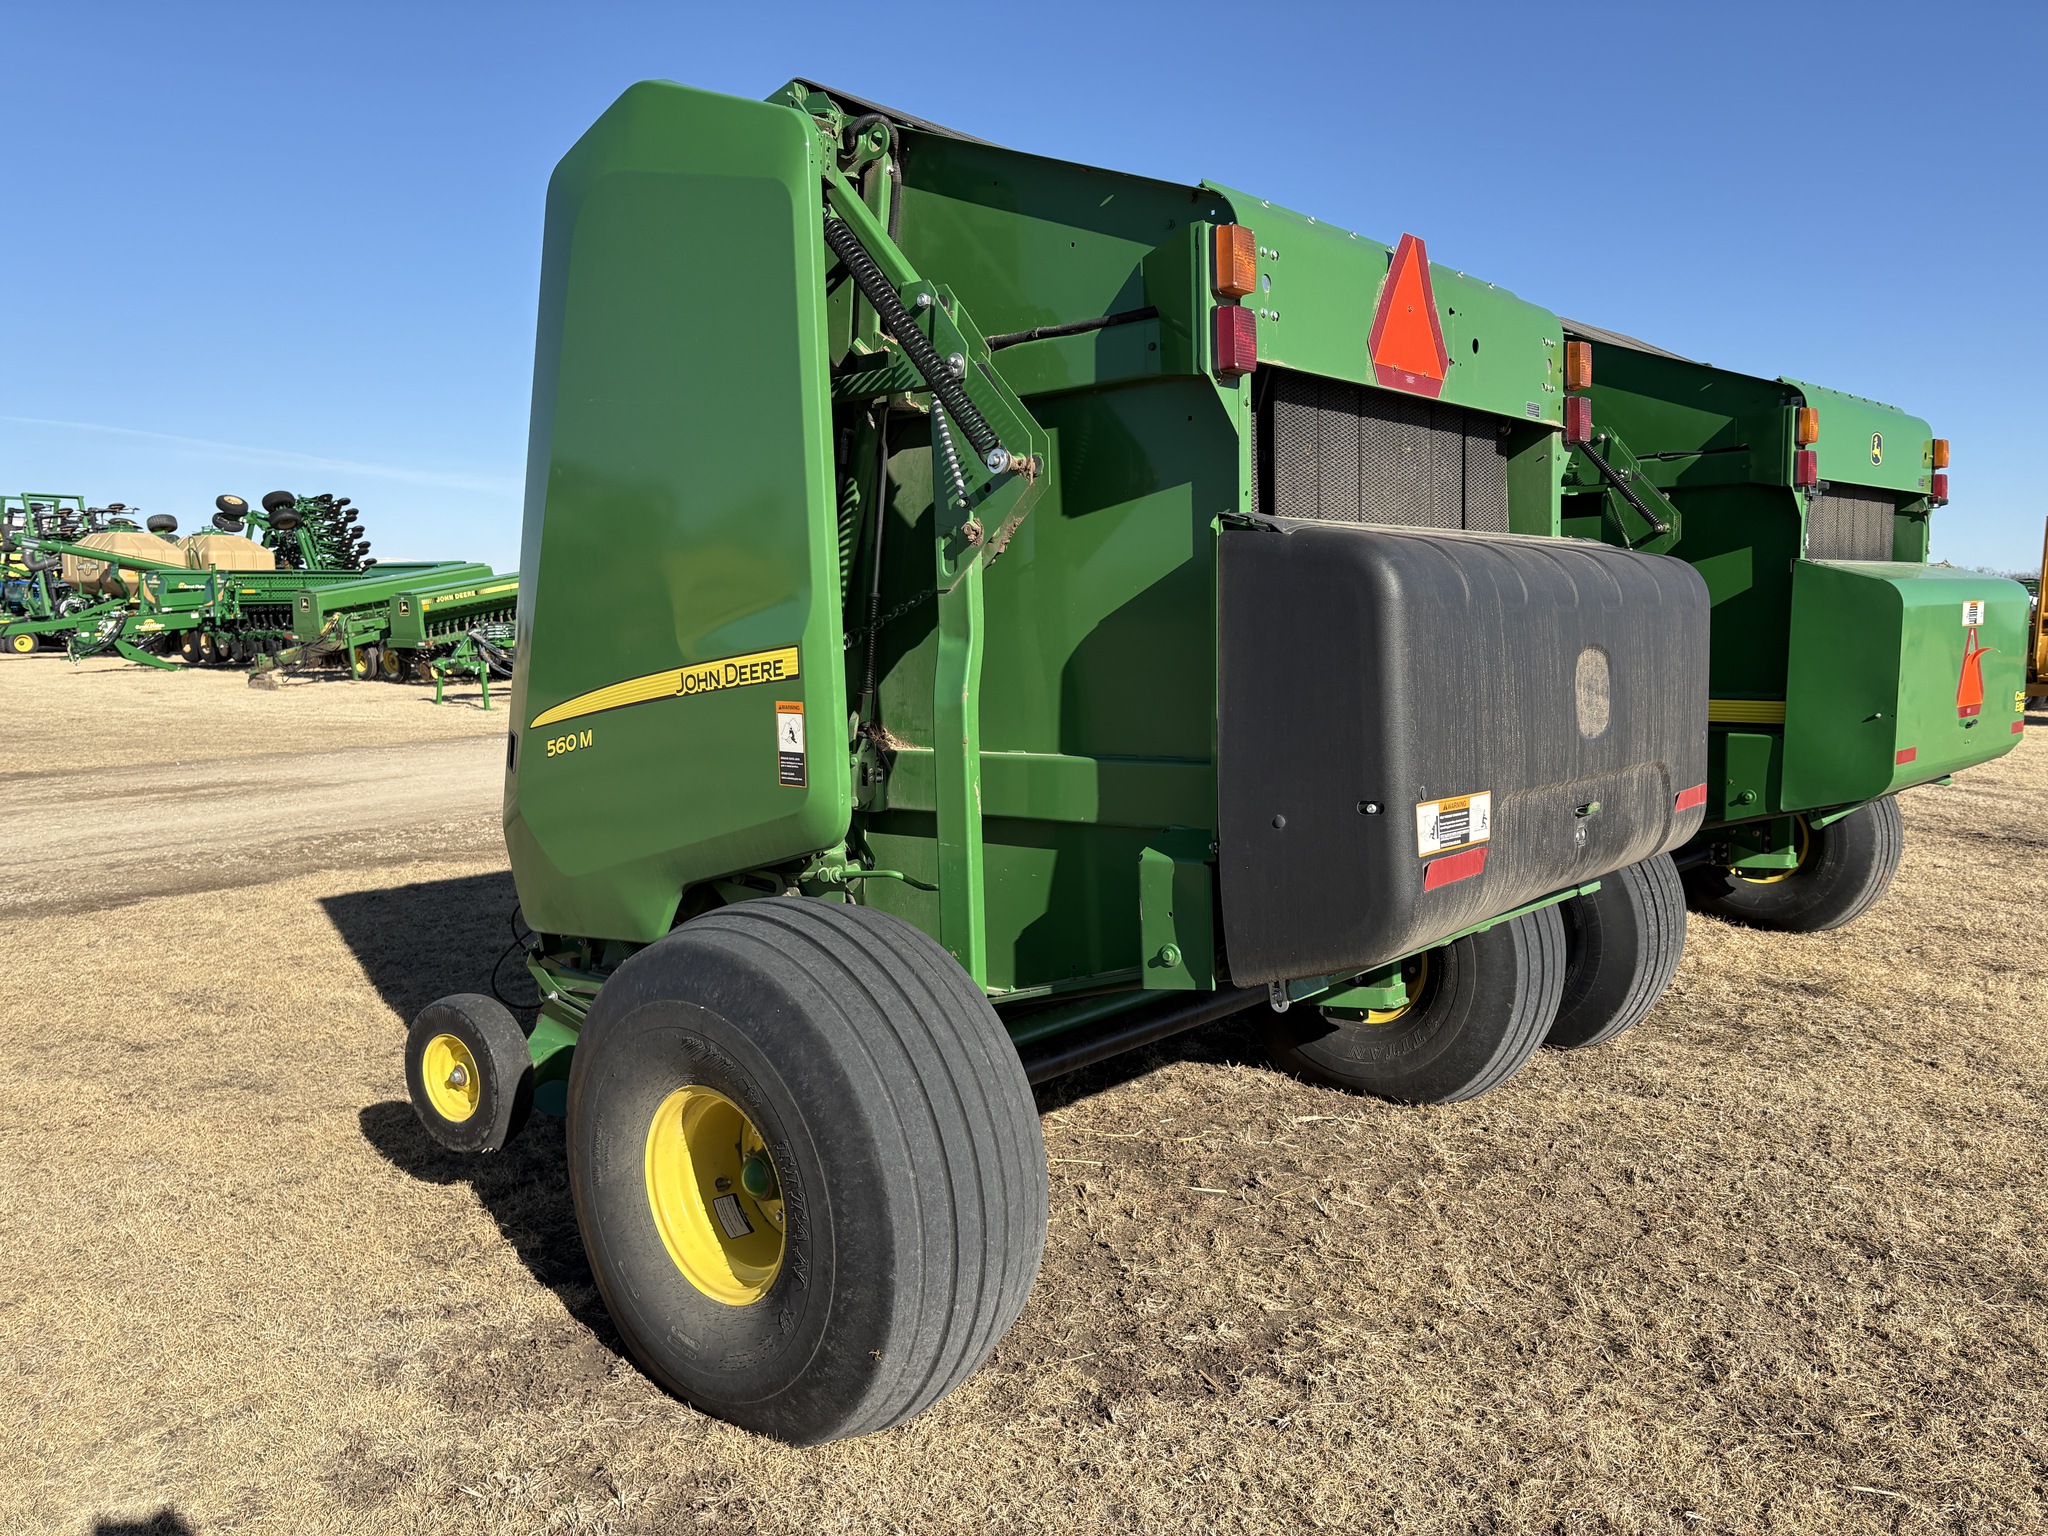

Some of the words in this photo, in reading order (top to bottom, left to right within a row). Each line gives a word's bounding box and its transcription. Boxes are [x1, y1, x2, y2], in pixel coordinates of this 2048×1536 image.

[436, 594, 454, 603] JOHN
[455, 590, 476, 600] DEERE
[676, 669, 720, 694] JOHN
[724, 659, 784, 685] DEERE
[547, 733, 577, 758] 560
[580, 728, 593, 749] M
[1448, 800, 1467, 810] WARNING
[1347, 1029, 1426, 1060] TITAN
[774, 1139, 809, 1292] TITAN
